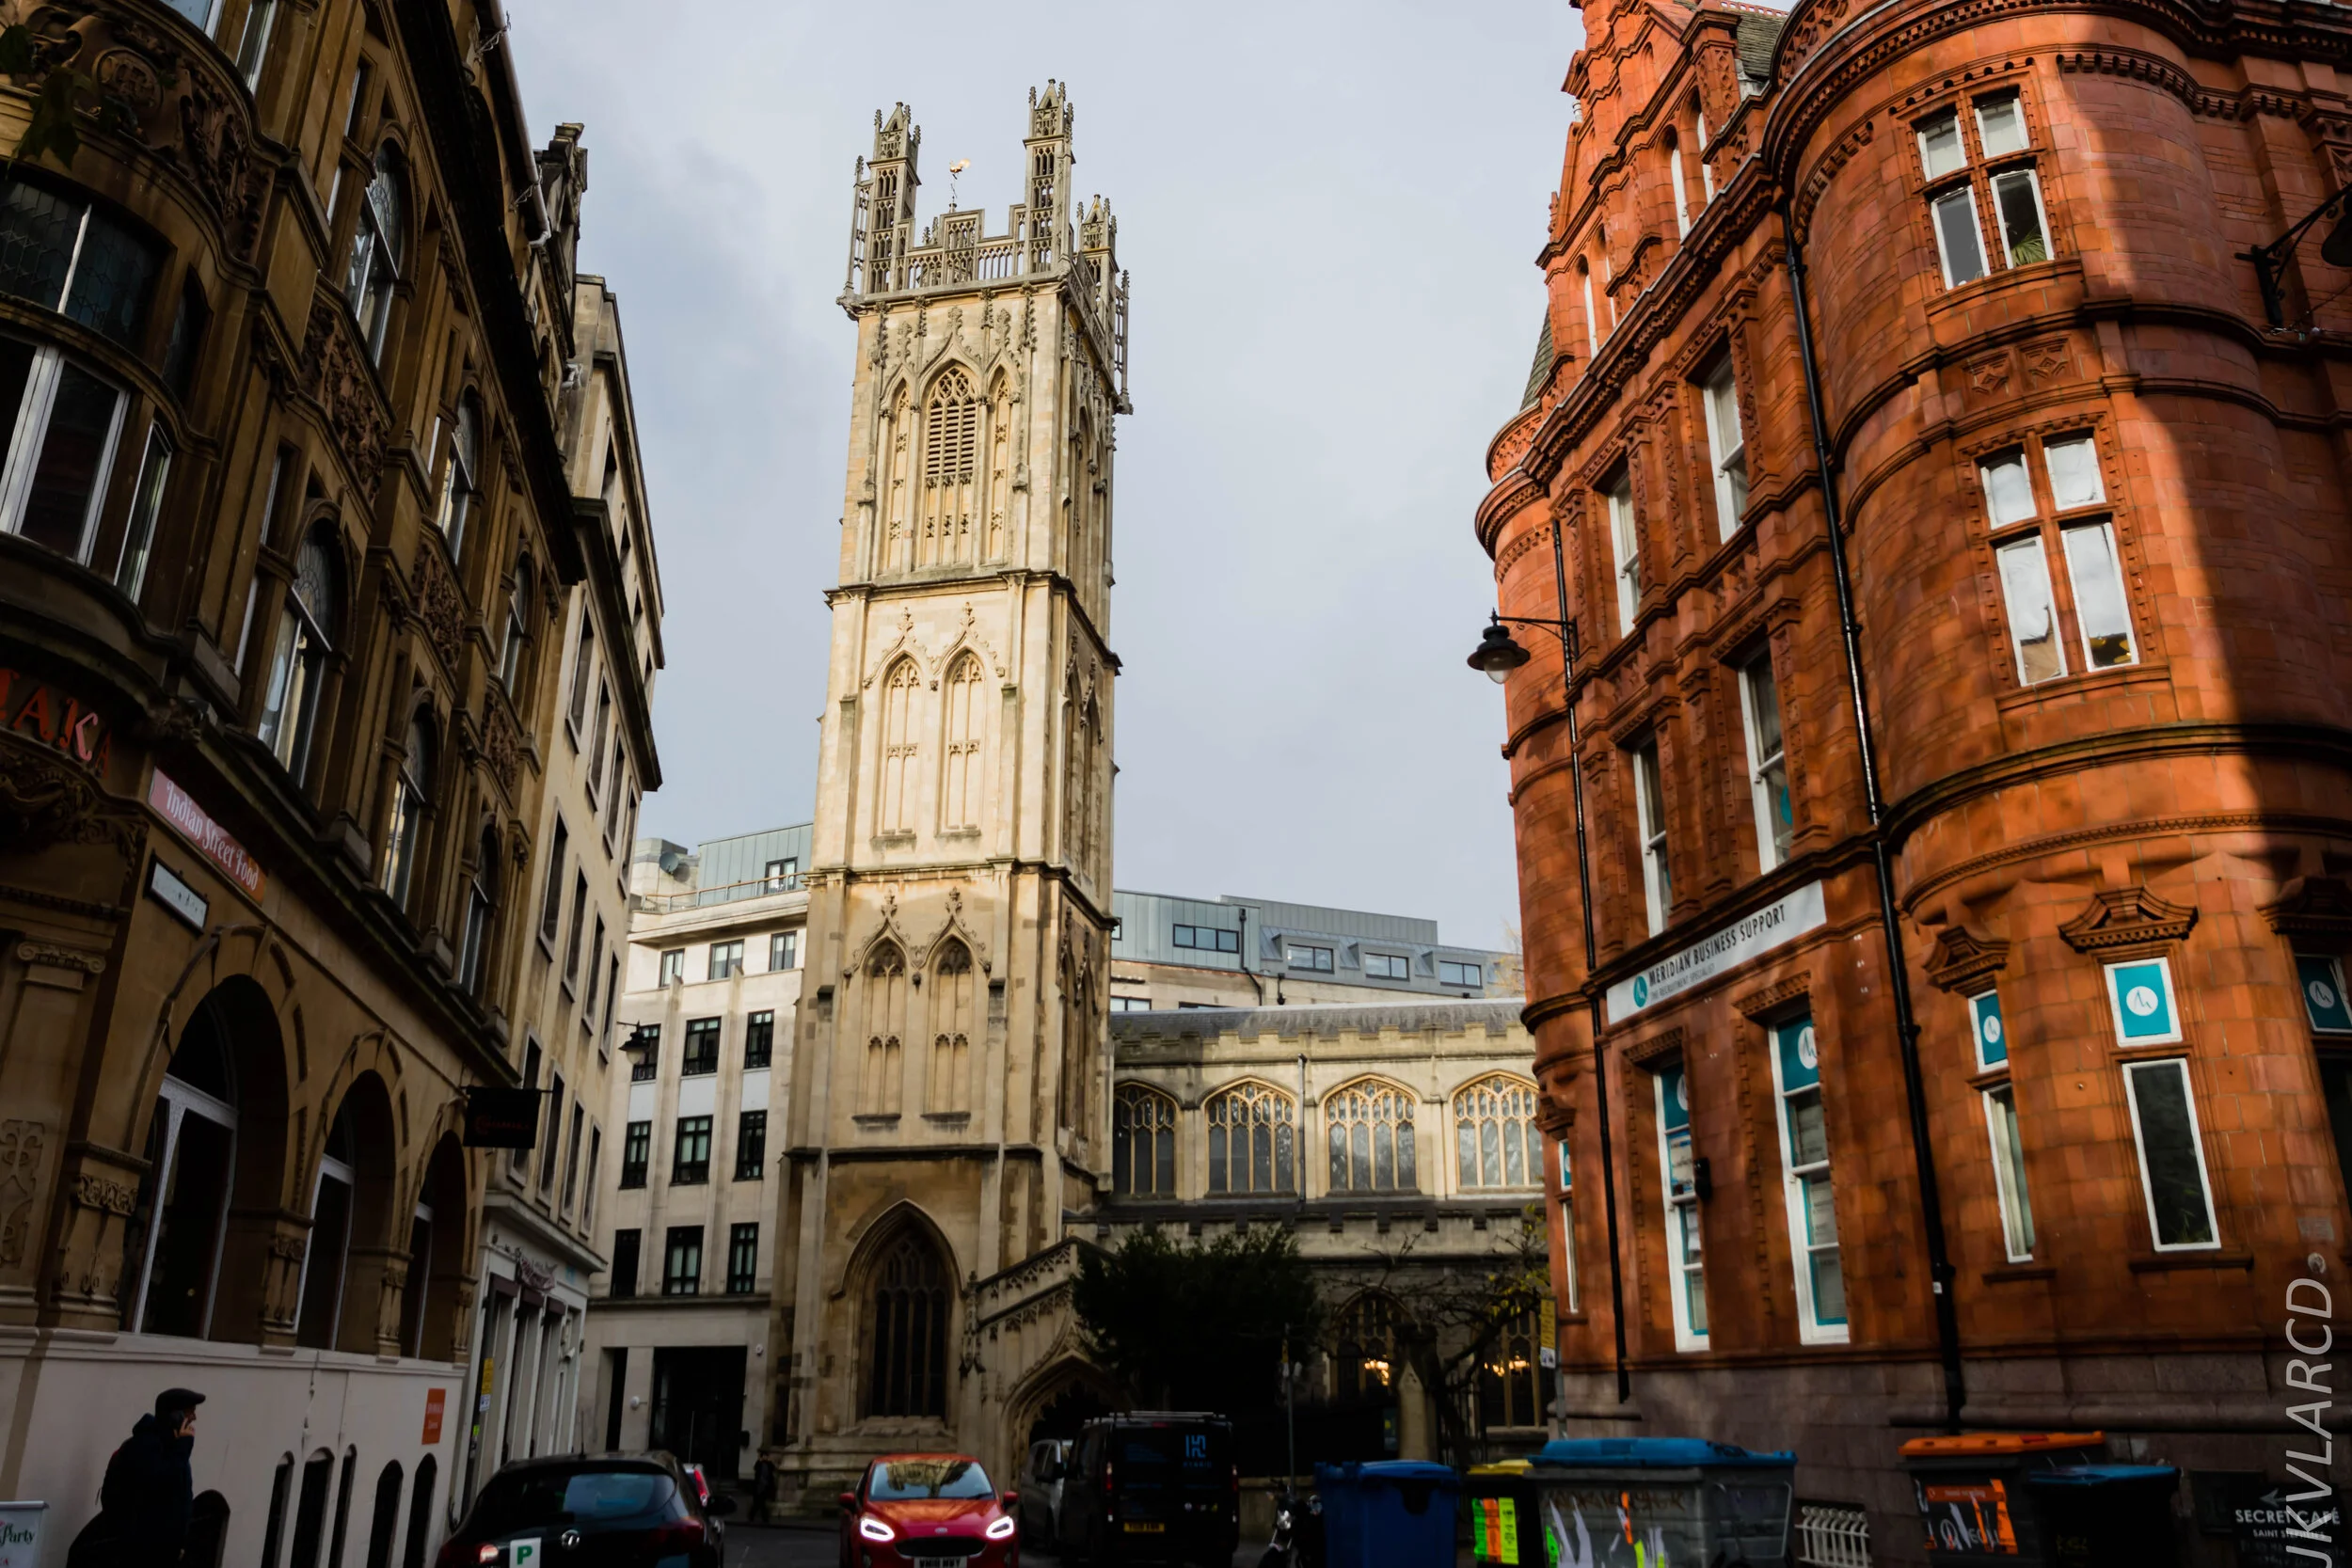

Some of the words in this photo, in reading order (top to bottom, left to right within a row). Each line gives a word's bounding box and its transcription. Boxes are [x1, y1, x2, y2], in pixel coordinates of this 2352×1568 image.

[167, 781, 203, 839] Indian
[202, 817, 236, 868] Street
[235, 849, 260, 892] Food
[1649, 951, 1692, 986] MERIDIAN
[1693, 929, 1737, 964] BUSINESS
[1740, 904, 1786, 942] SUPPORT
[2235, 1508, 2292, 1525] SECRET
[2252, 1528, 2279, 1539] SAINT
[516, 1545, 533, 1565] P
